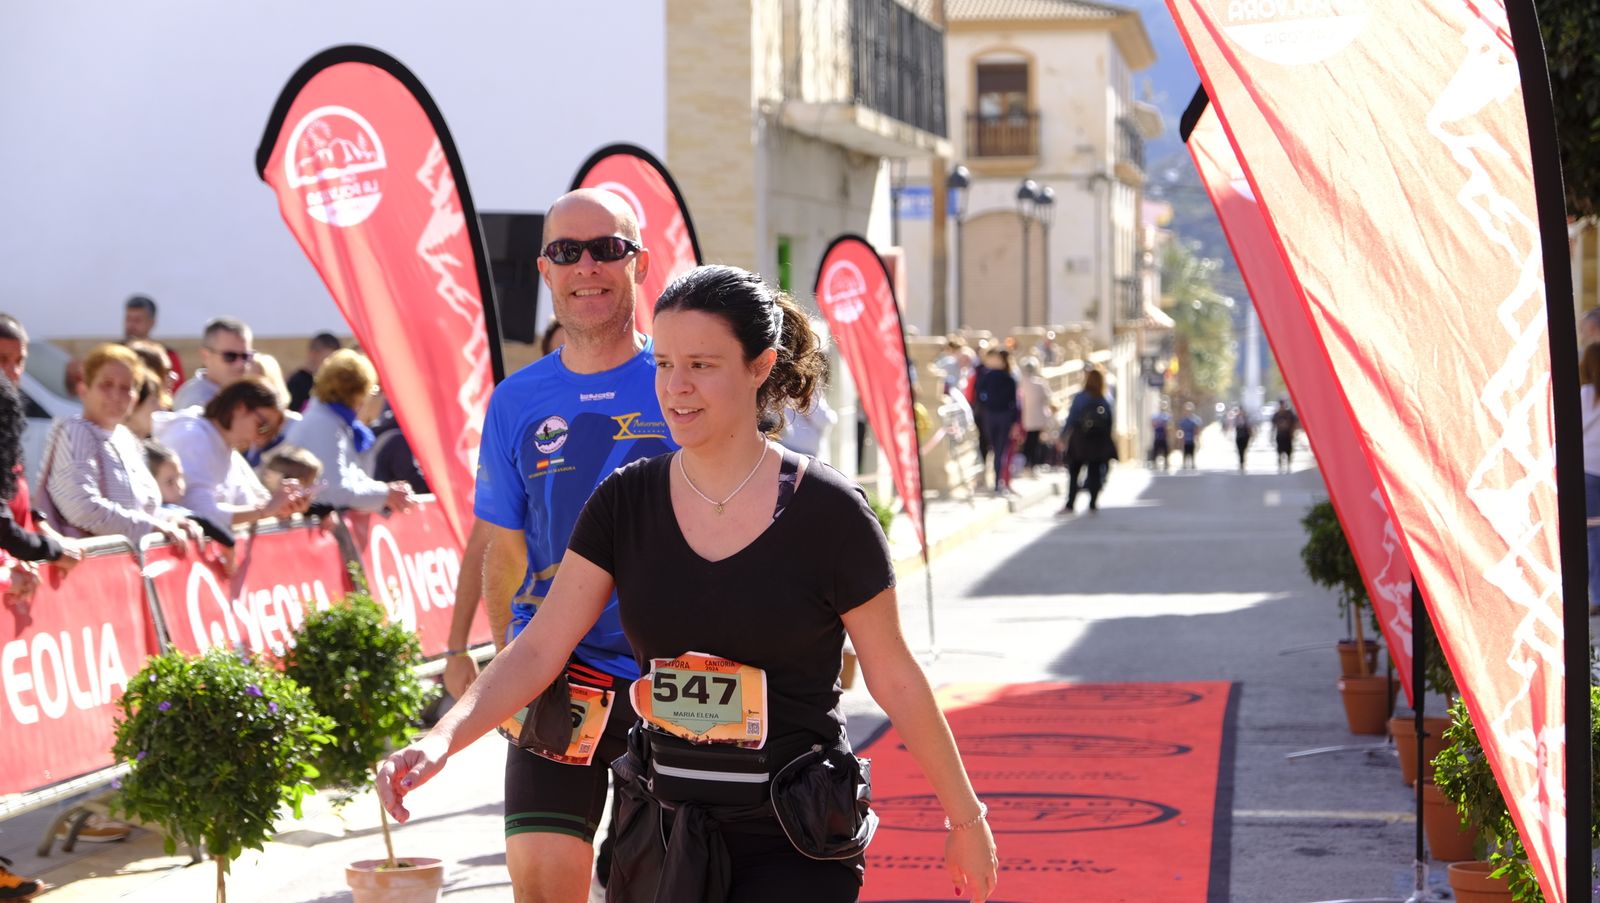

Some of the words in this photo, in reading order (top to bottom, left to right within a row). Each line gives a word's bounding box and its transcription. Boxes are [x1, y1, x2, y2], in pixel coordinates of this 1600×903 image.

[704, 659, 735, 668] CANTORIA
[1, 622, 129, 725] EOLIA
[653, 672, 737, 705] 547
[696, 712, 719, 720] ELENA
[865, 855, 1032, 865] Ctoria
[866, 863, 1117, 876] Ayuntien
